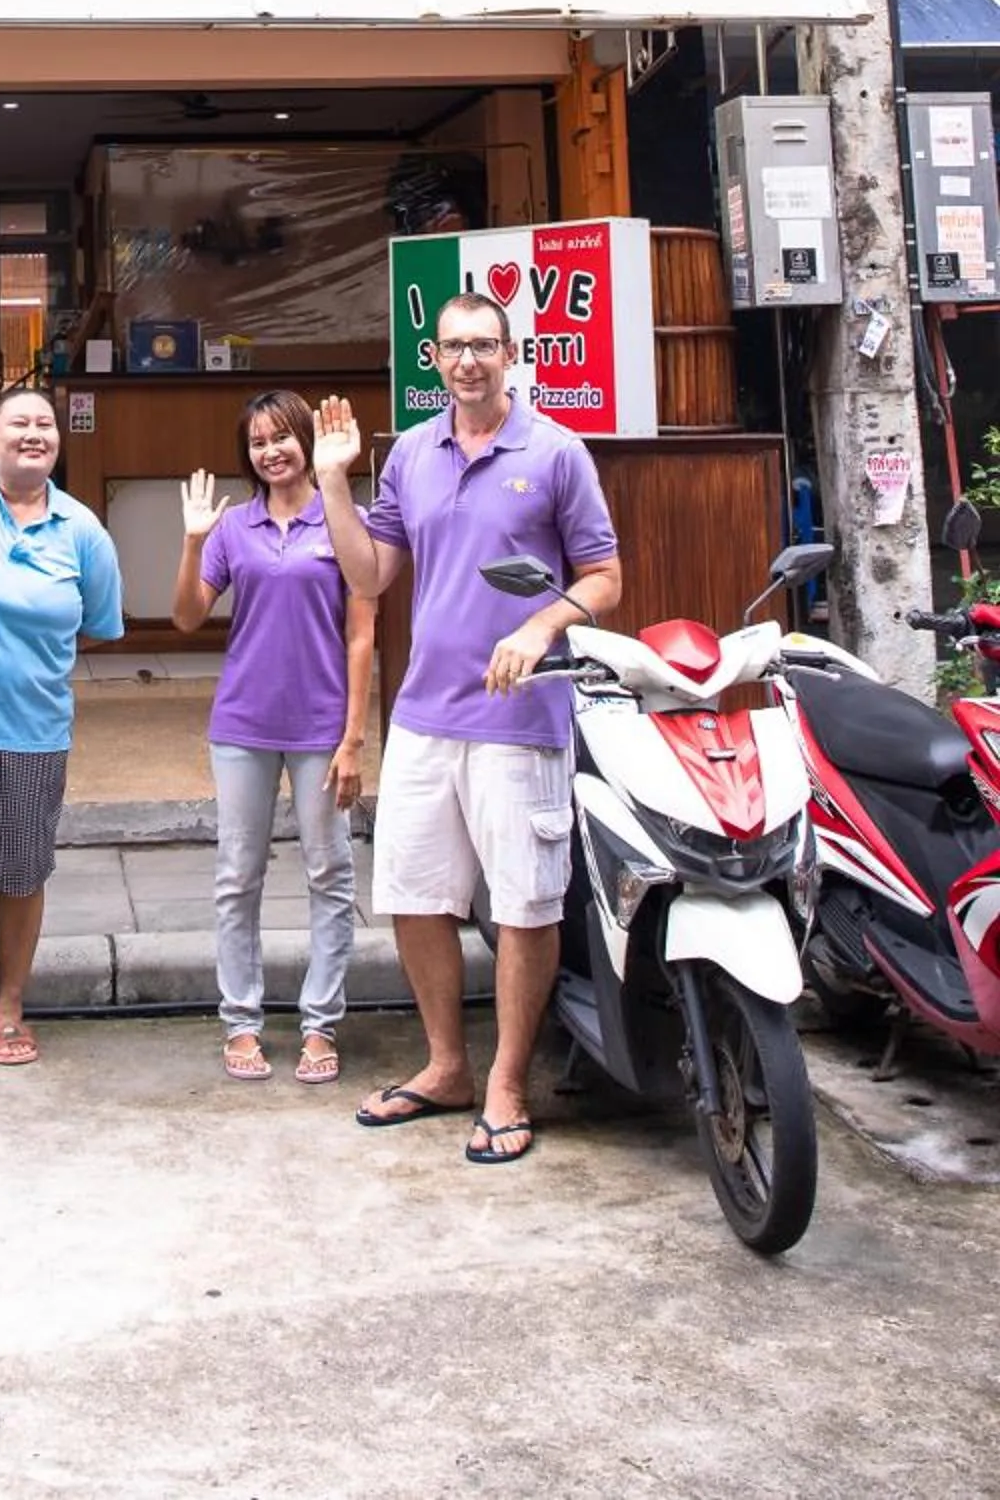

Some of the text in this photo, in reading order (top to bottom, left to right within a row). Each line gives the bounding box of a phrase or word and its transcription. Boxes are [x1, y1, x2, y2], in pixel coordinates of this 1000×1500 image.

[408, 284, 424, 329] I
[418, 333, 585, 370] SETTI
[529, 383, 602, 408] Pizzeria
